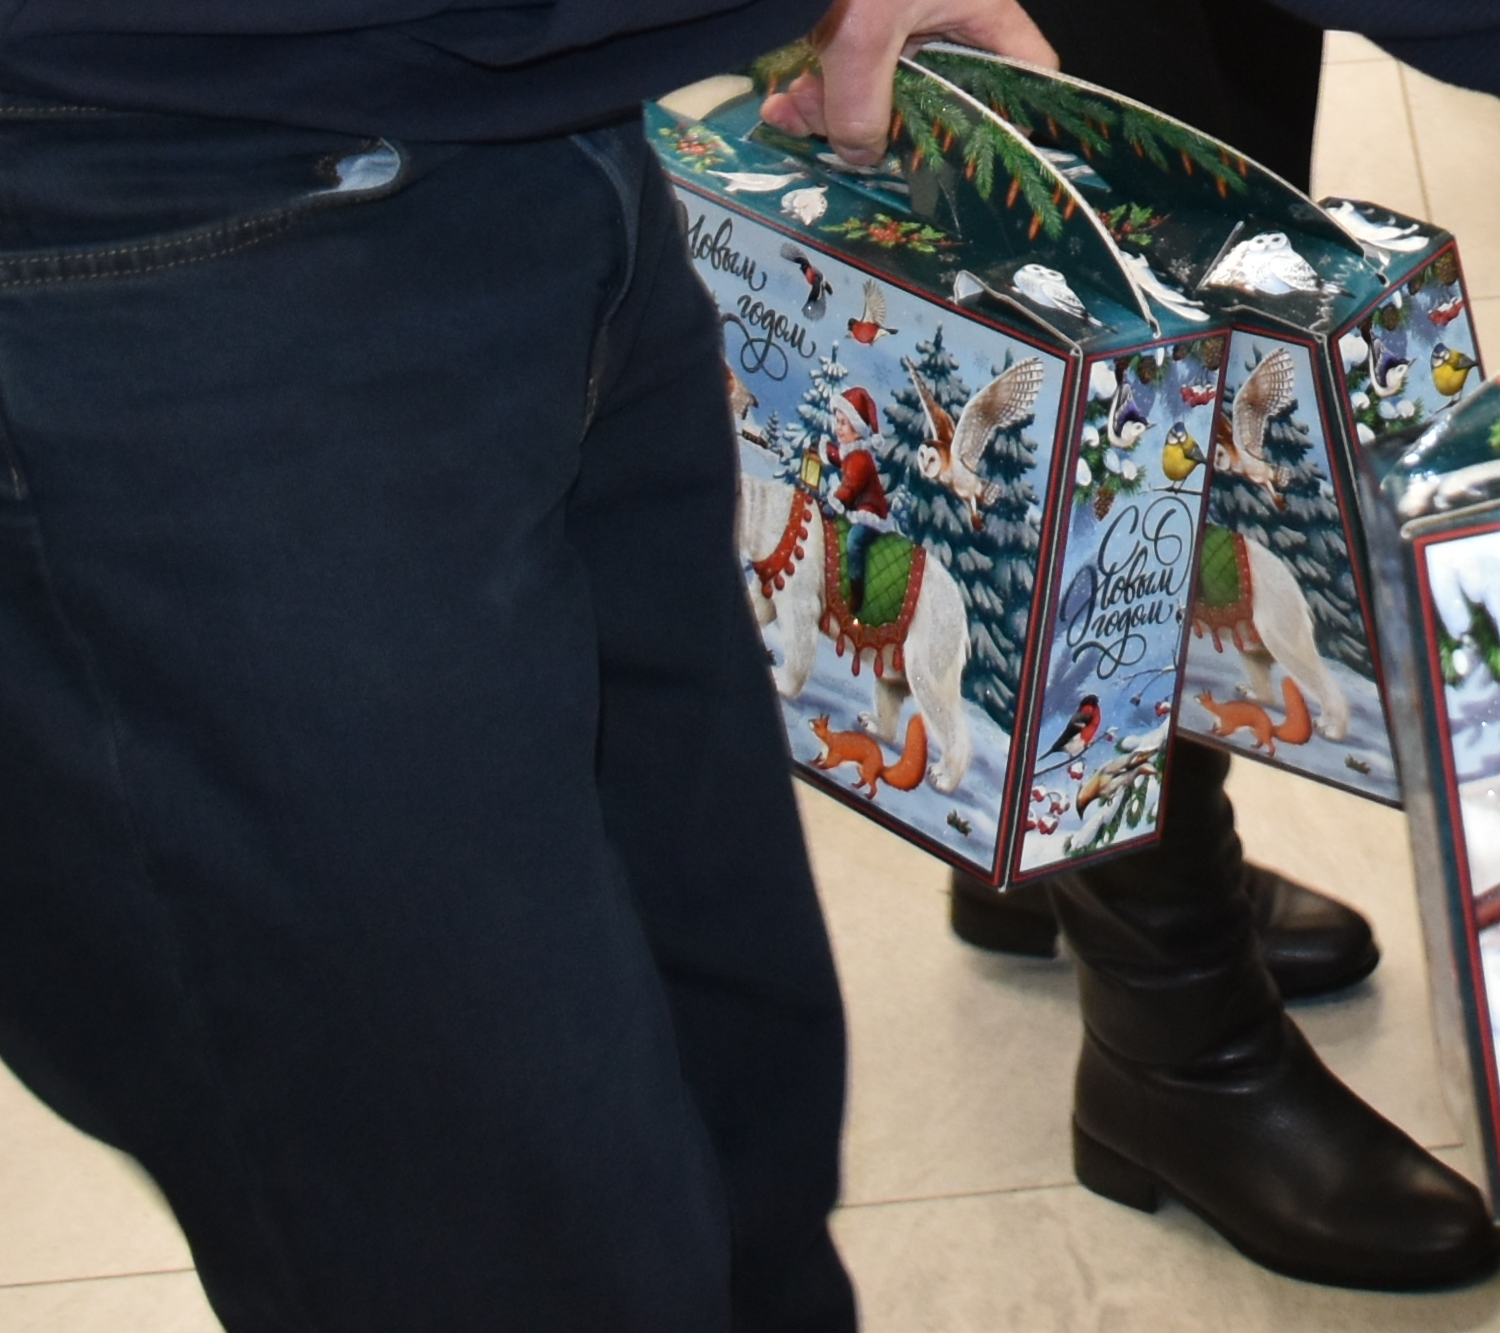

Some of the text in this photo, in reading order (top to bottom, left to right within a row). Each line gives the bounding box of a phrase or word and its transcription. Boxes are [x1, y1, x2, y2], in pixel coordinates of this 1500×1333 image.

[721, 294, 817, 381] годом
[1097, 505, 1140, 576] С
[1073, 599, 1174, 679] годом
